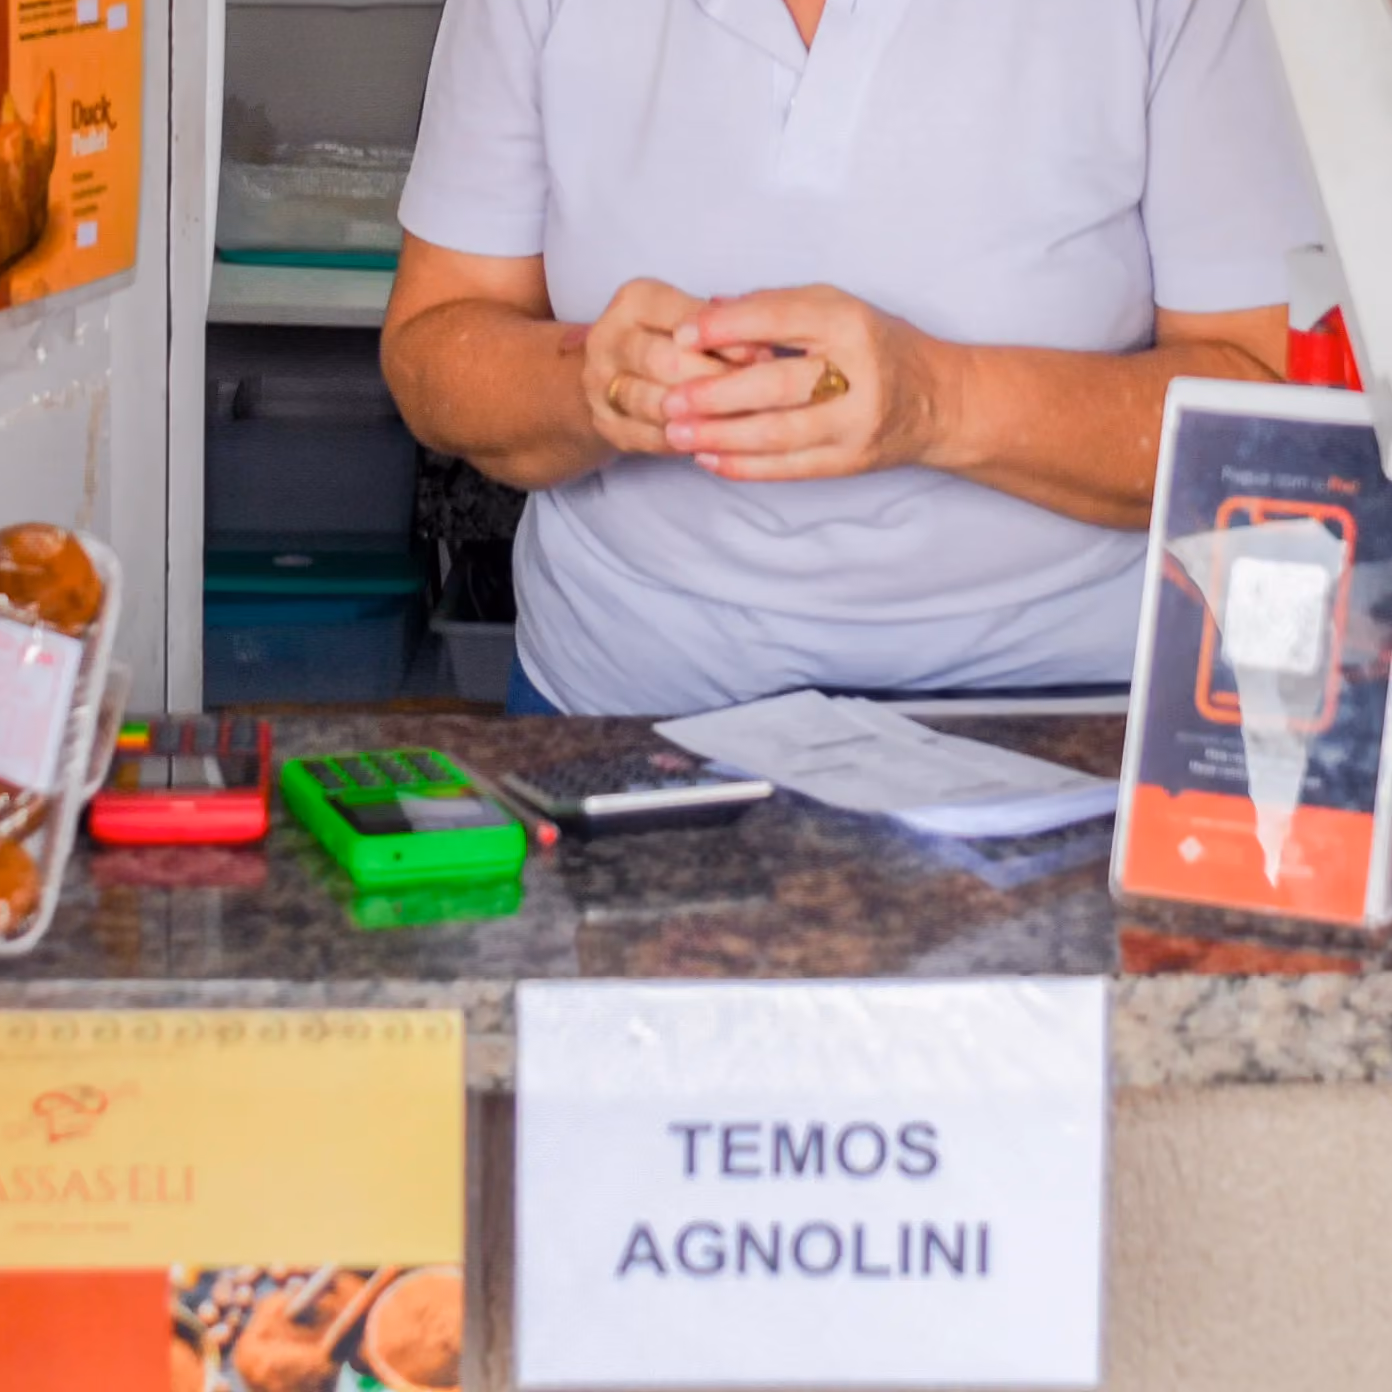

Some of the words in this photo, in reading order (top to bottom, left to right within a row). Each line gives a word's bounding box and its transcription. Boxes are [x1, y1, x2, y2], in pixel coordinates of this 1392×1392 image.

[668, 1121, 940, 1177] TEMOS
[128, 1165, 194, 1202] ELI
[615, 1220, 990, 1277] AGNOLINI
